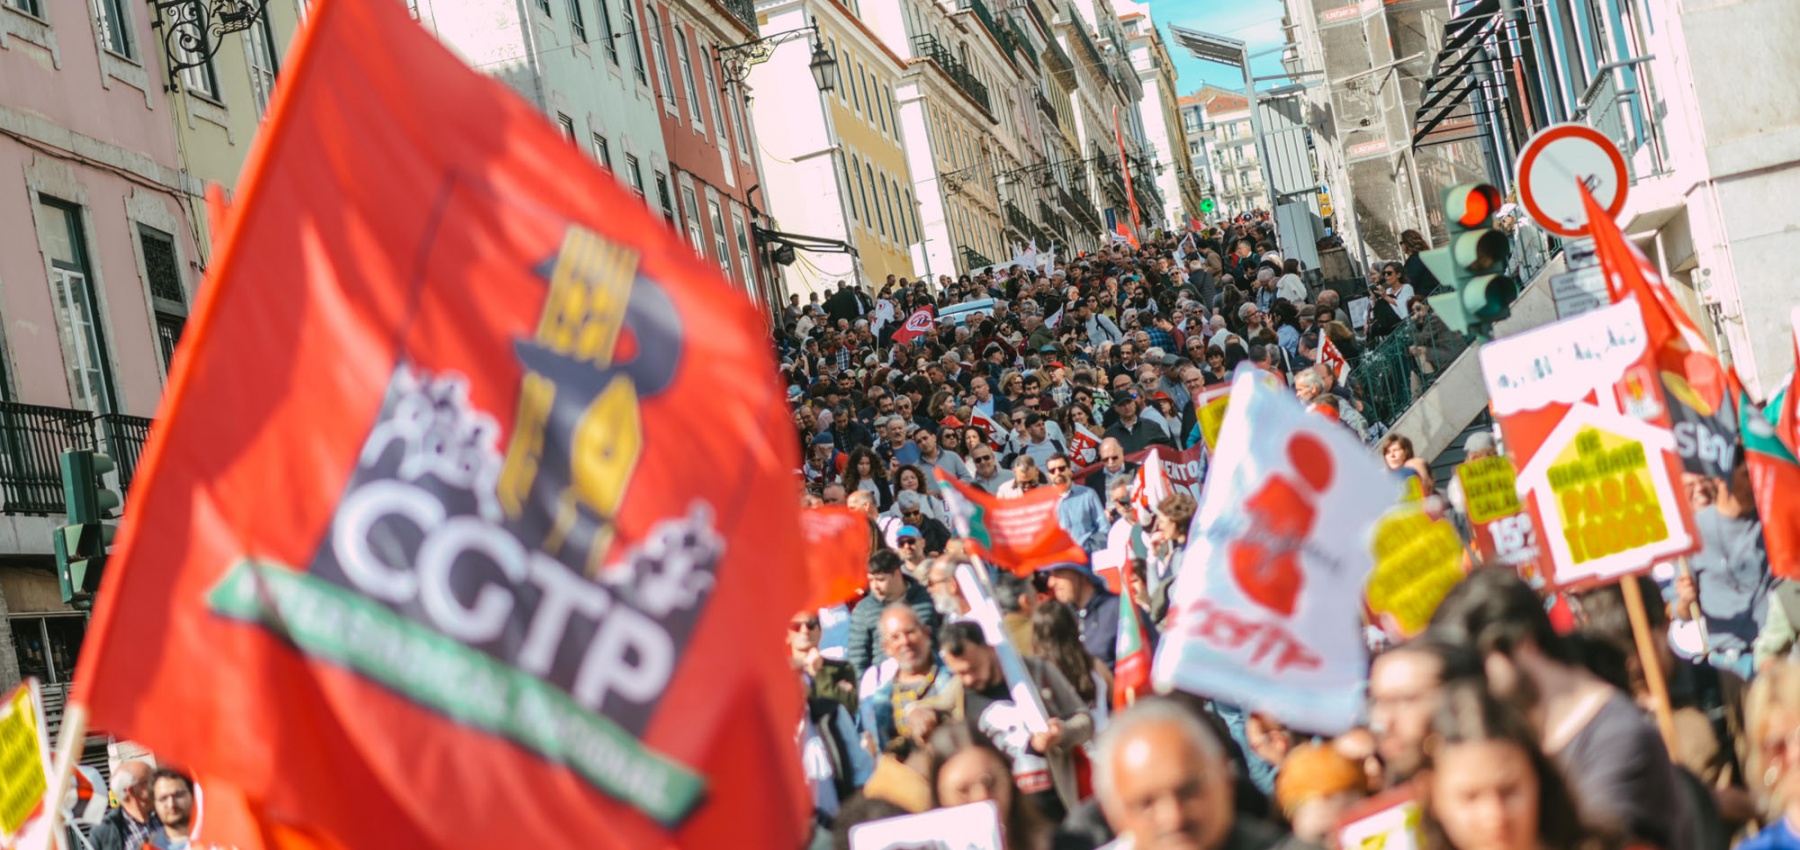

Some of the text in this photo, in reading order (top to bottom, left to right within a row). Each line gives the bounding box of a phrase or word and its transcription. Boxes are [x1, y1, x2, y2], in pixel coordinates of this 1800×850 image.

[1561, 470, 1649, 524] PARA
[1564, 504, 1669, 564] TODOS
[332, 478, 676, 711] CGTP
